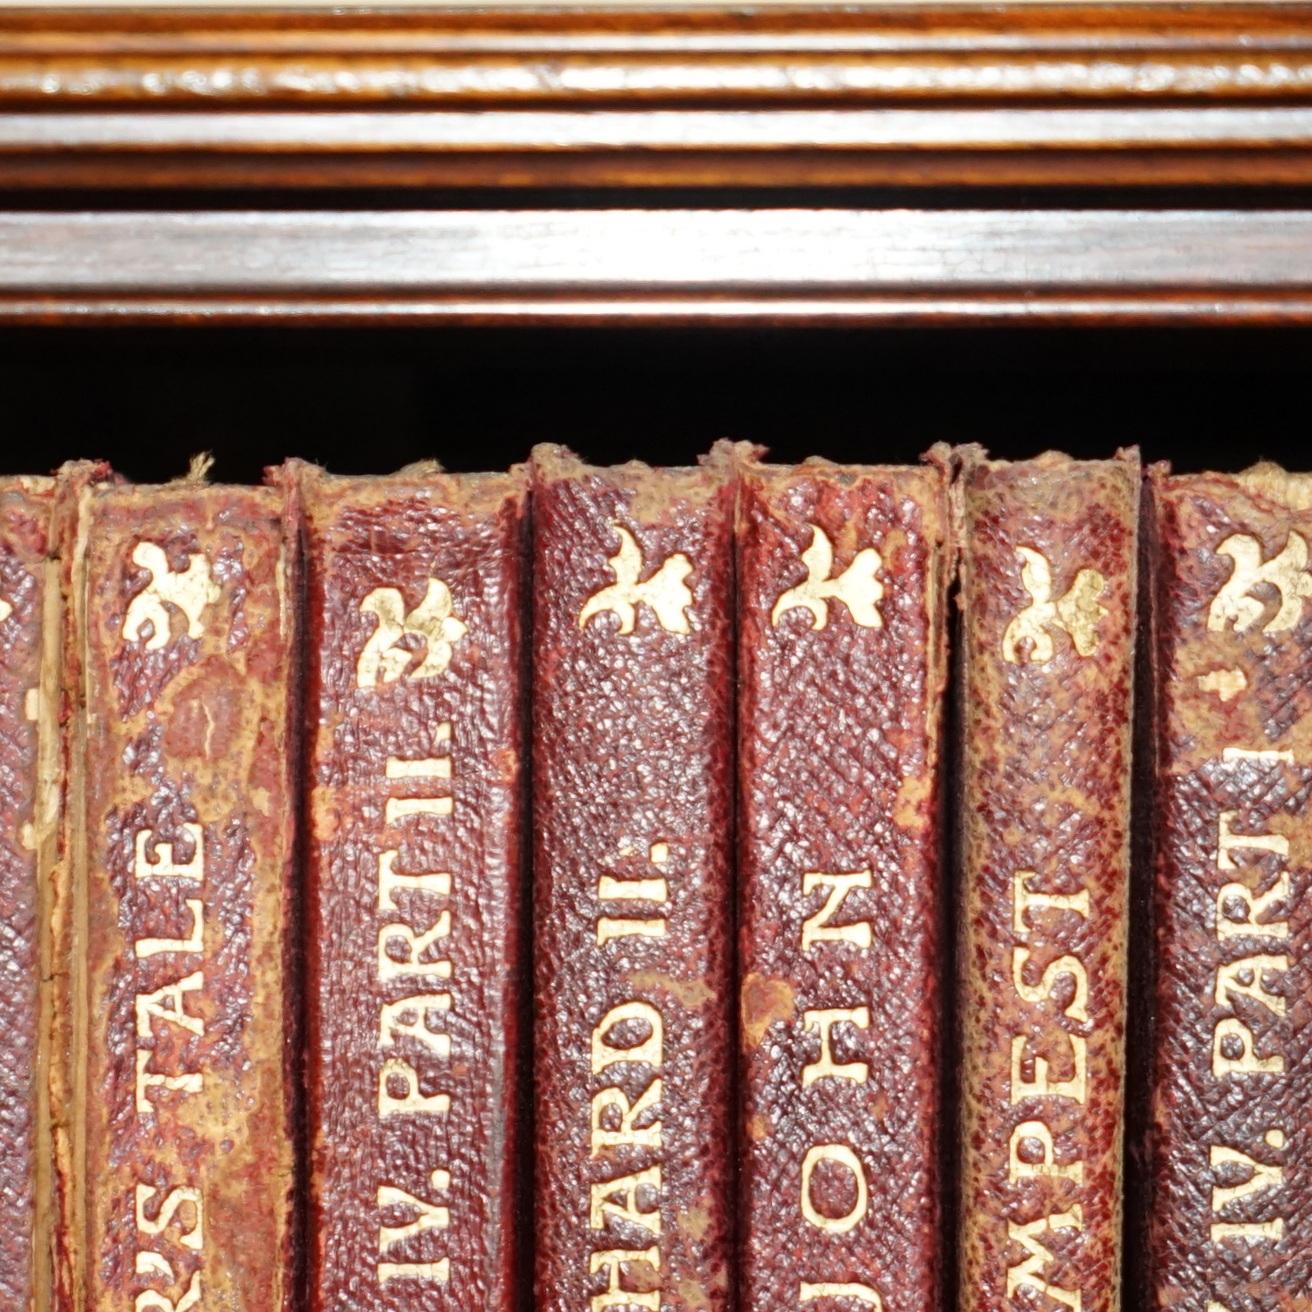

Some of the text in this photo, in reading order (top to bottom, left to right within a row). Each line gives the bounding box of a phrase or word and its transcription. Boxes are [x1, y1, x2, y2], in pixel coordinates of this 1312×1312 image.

[386, 723, 453, 825] II.
[1222, 748, 1294, 767] I
[597, 842, 667, 946] II.
[1212, 810, 1290, 1084] PART
[136, 823, 205, 1114] TALE
[378, 850, 451, 1119] PART
[377, 1170, 451, 1283] IV.
[1210, 1127, 1287, 1245] IV.
